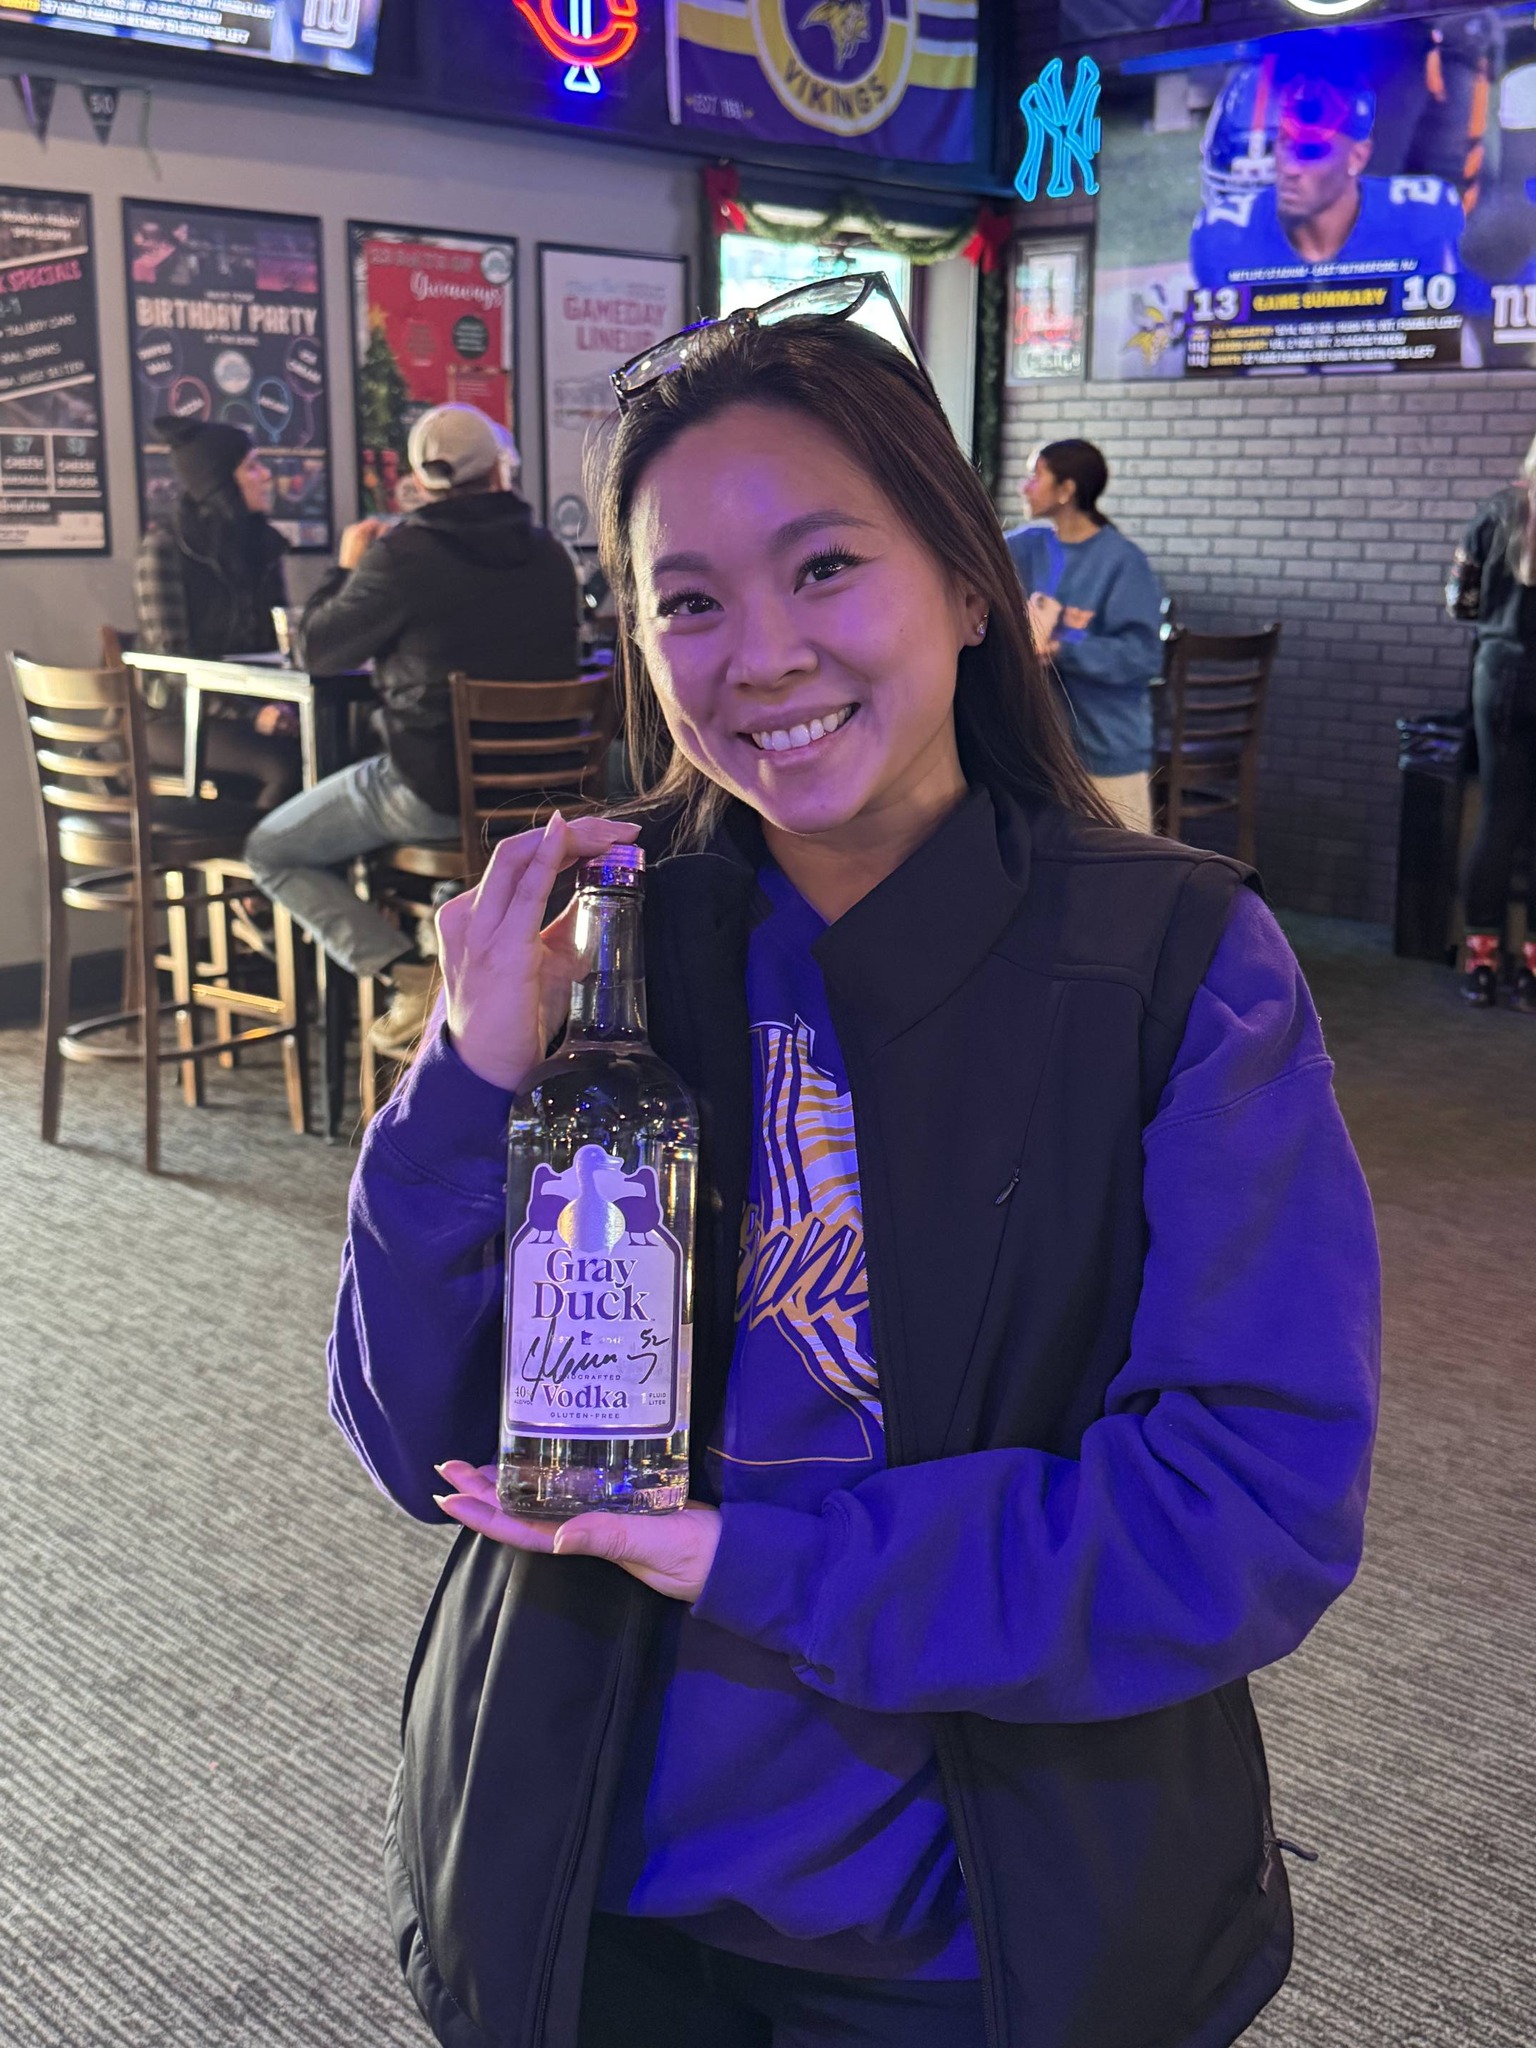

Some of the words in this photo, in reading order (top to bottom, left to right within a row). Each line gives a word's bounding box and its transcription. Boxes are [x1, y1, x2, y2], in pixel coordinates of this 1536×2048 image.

[783, 57, 889, 117] VIKINGS
[1014, 55, 1101, 202] NY
[563, 295, 666, 327] GAMEDAY
[1192, 286, 1240, 321] 13
[1252, 293, 1300, 312] GAME
[1302, 288, 1387, 309] SUMMARY
[1402, 273, 1456, 311] 10
[136, 296, 242, 331] BIRTHDAY
[248, 304, 317, 336] PARTY
[546, 1248, 637, 1289] Gray
[531, 1281, 650, 1321] Duck
[542, 1384, 629, 1410] Vodka
[550, 1412, 621, 1420] GLUTEN-FREE
